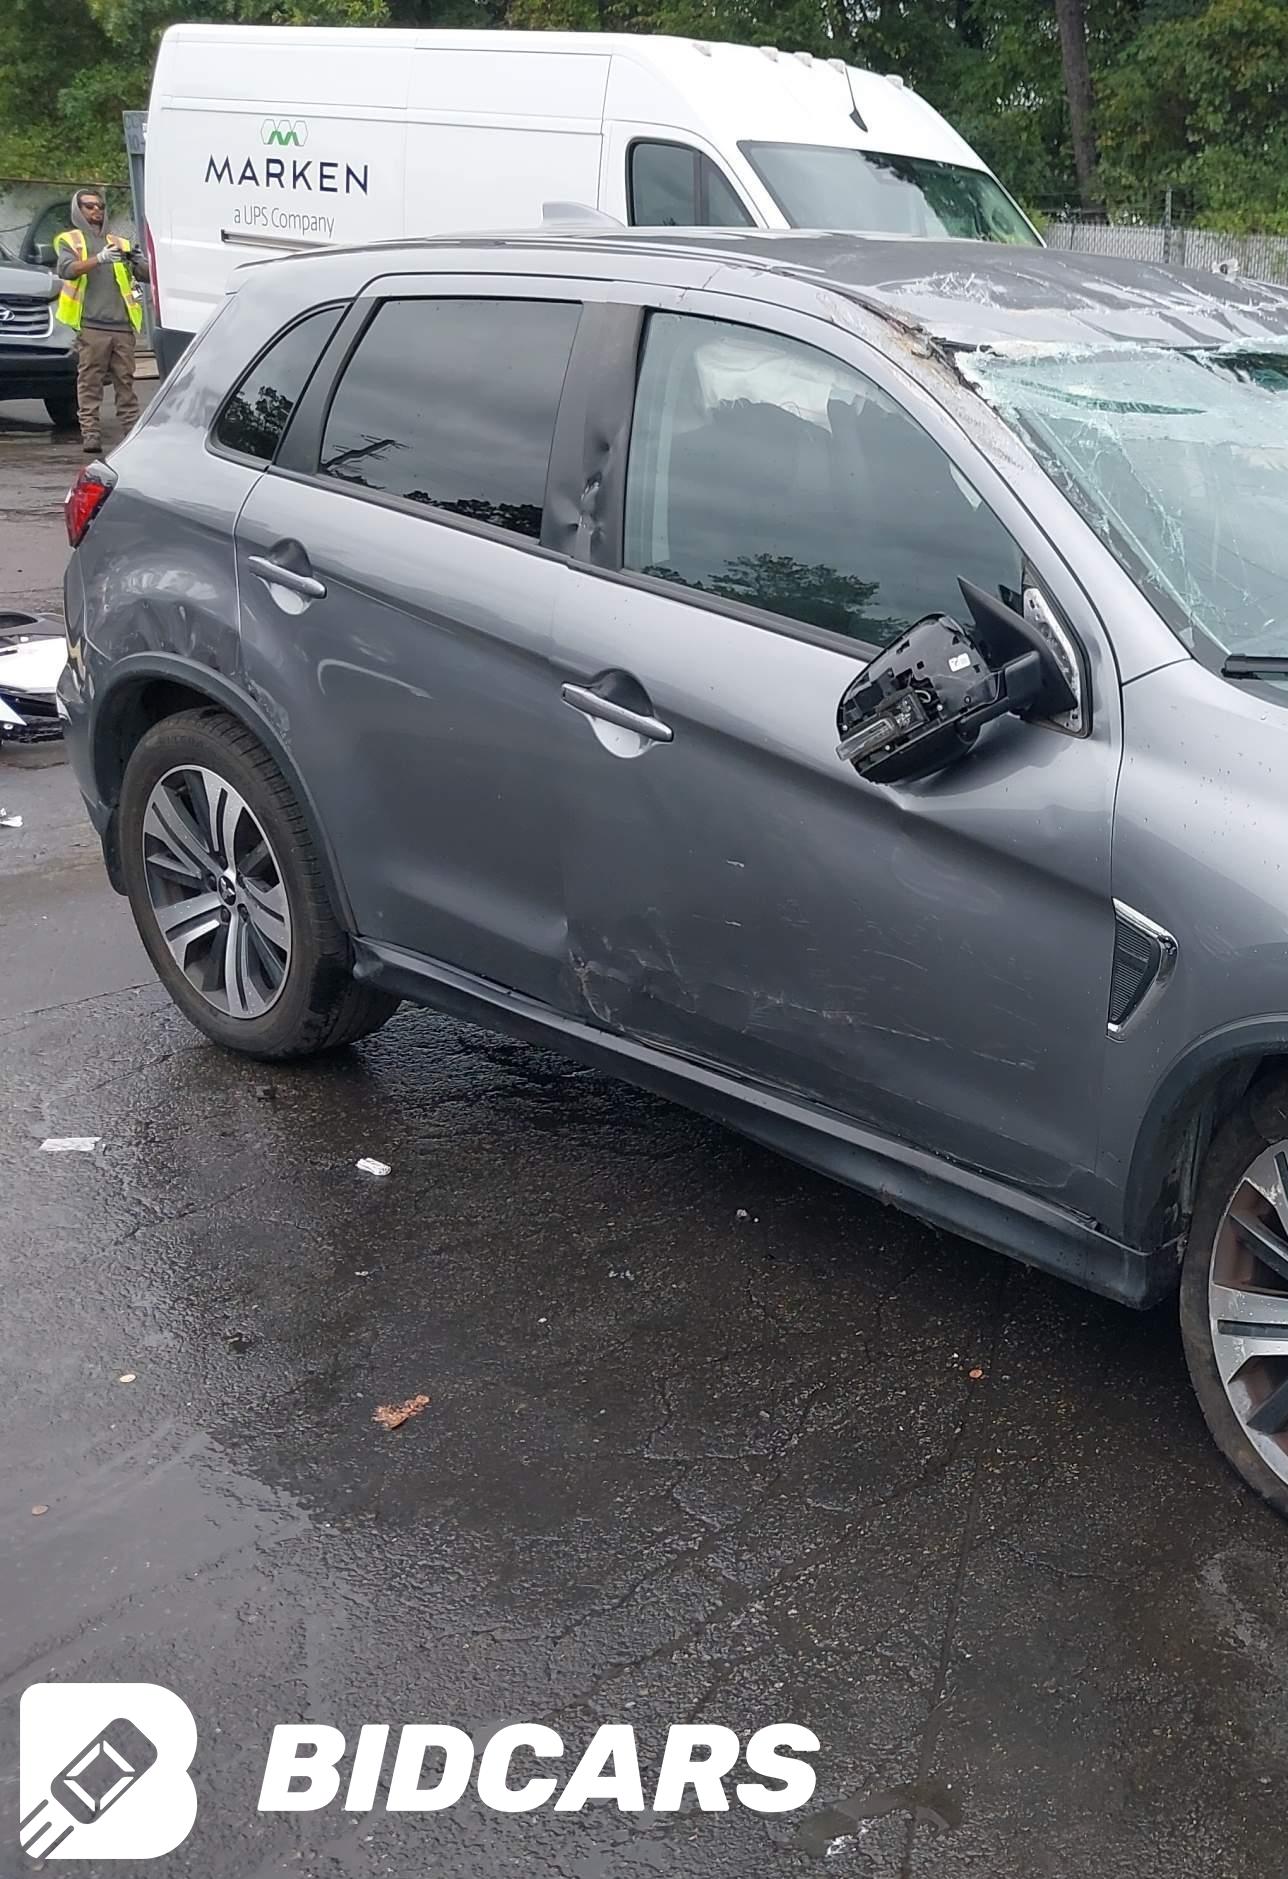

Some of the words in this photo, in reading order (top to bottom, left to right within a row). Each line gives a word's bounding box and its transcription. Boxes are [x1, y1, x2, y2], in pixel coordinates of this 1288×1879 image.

[204, 154, 369, 196] MARKEN
[233, 208, 242, 224] a
[243, 204, 269, 228] UPS
[271, 207, 335, 238] Company
